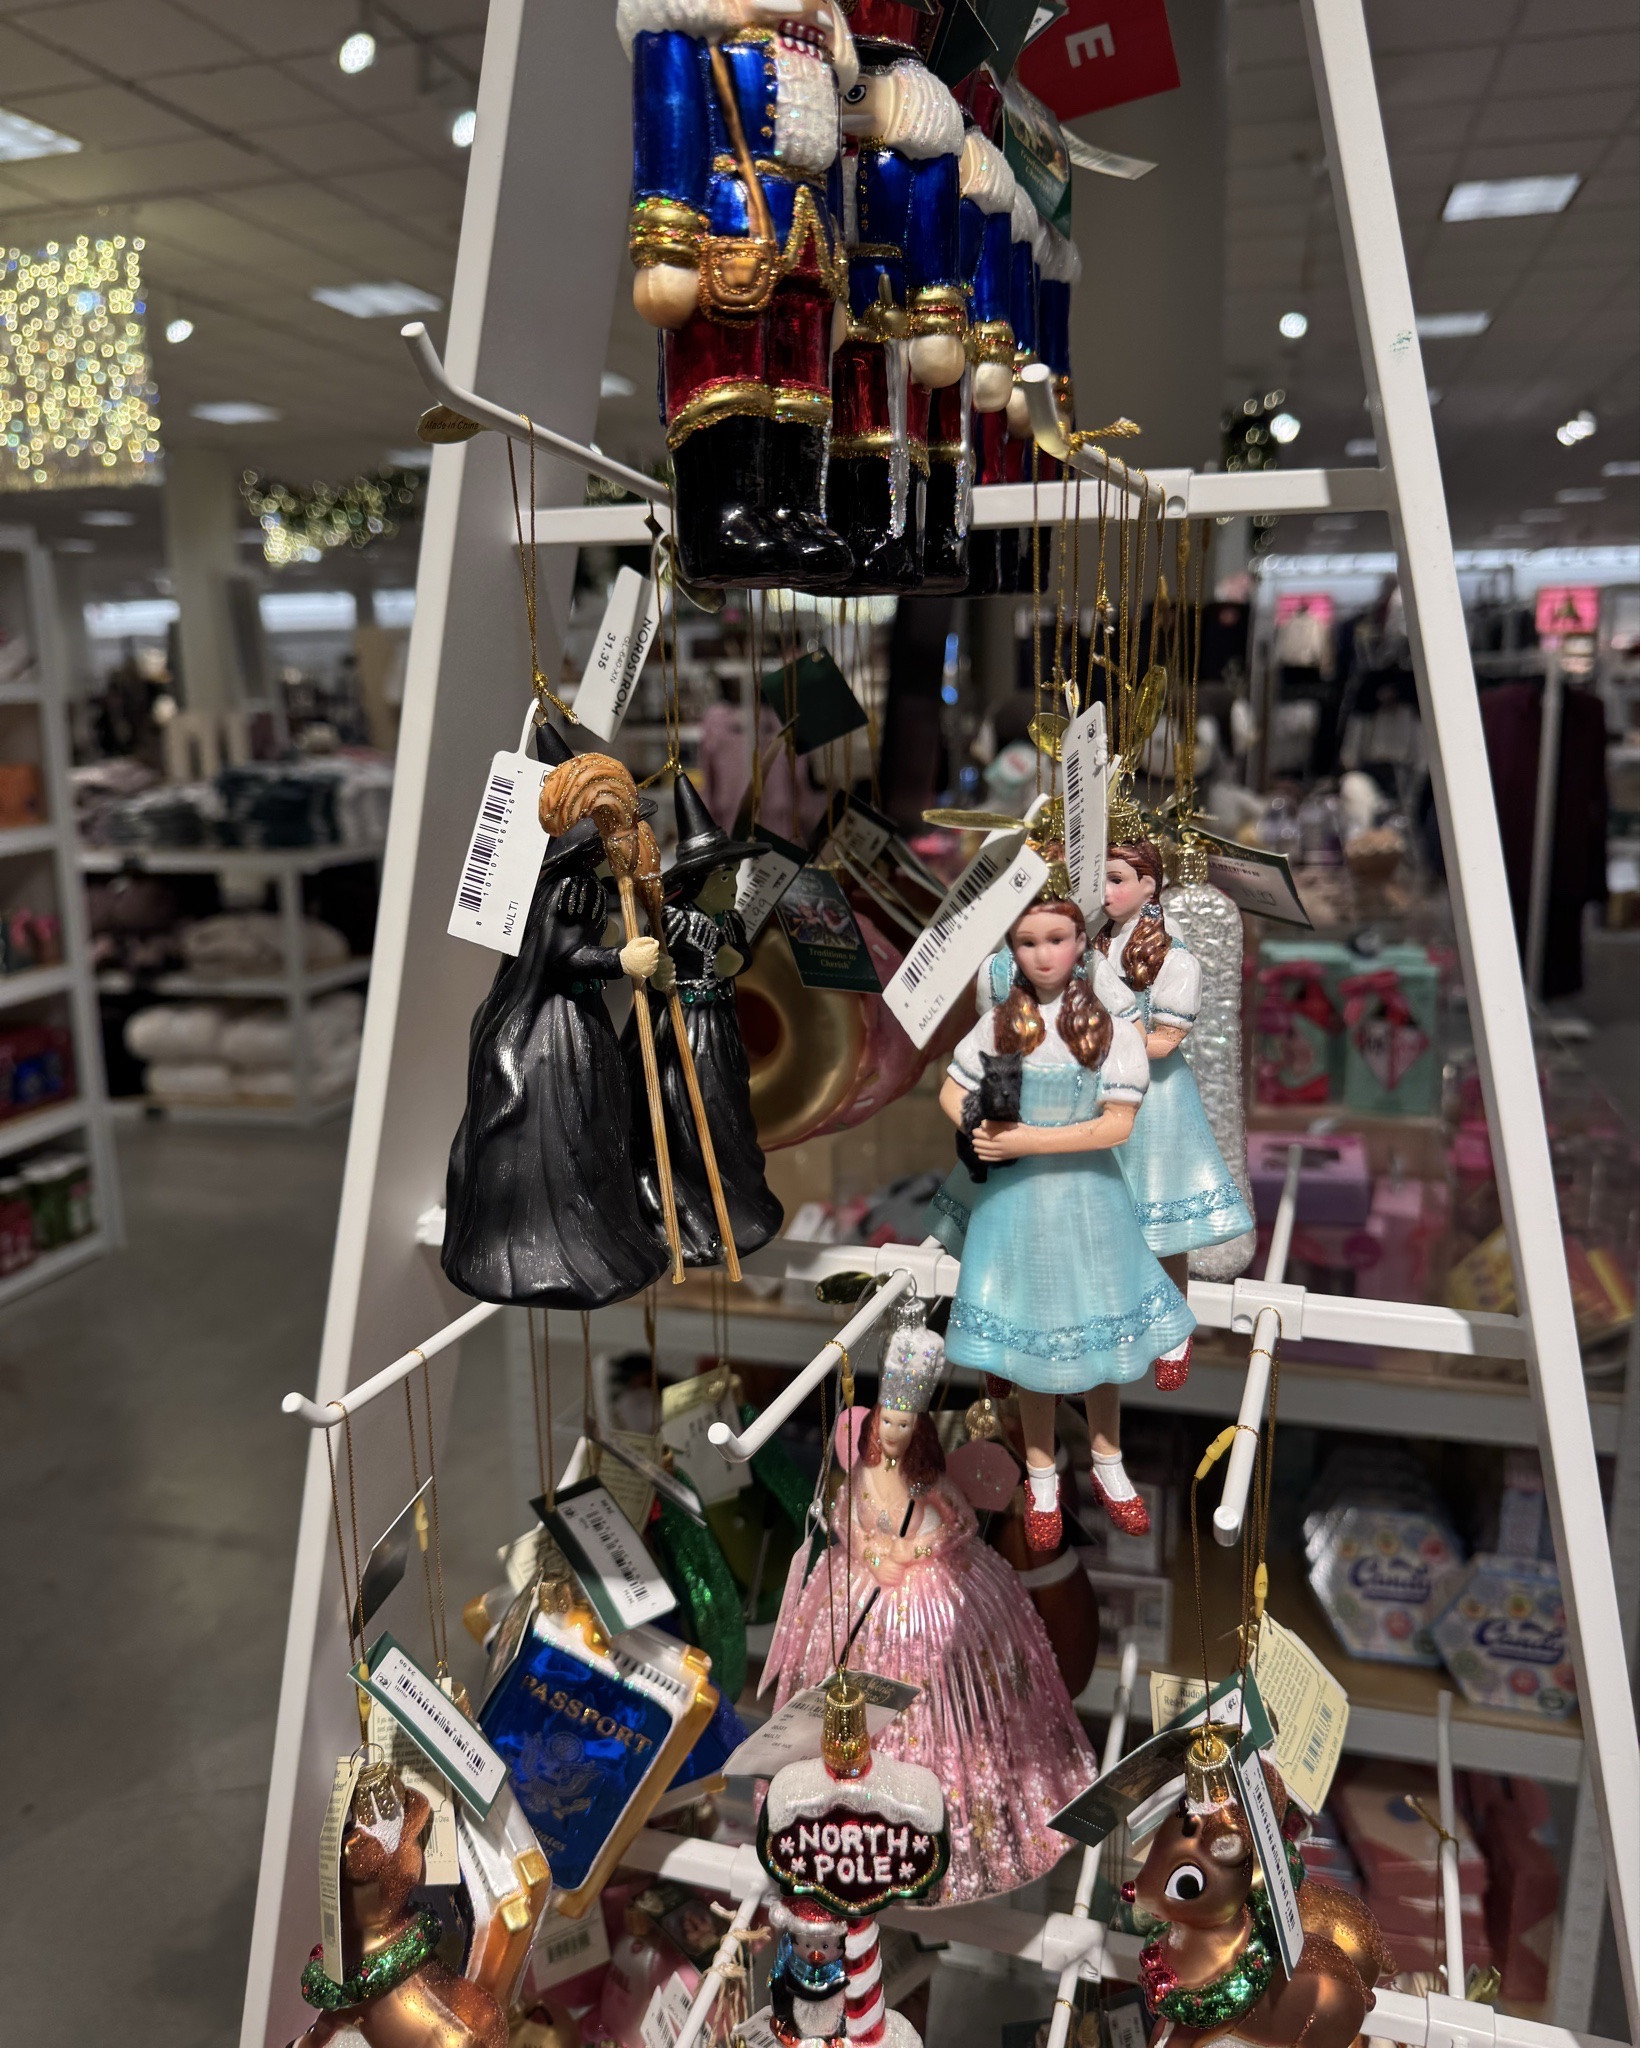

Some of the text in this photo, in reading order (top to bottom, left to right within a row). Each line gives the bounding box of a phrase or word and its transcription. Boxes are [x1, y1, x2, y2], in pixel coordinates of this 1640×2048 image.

[425, 420, 446, 430] Made
[448, 420, 456, 430] in
[612, 617, 652, 717] NORDSTROM
[483, 852, 500, 897] 10107
[497, 798, 515, 844] 66426
[502, 900, 519, 936] MULTI
[918, 994, 945, 1031] MULTI
[521, 1674, 653, 1755] PASSPORT
[799, 1821, 909, 1858] NORTH
[813, 1853, 893, 1884] POLE
